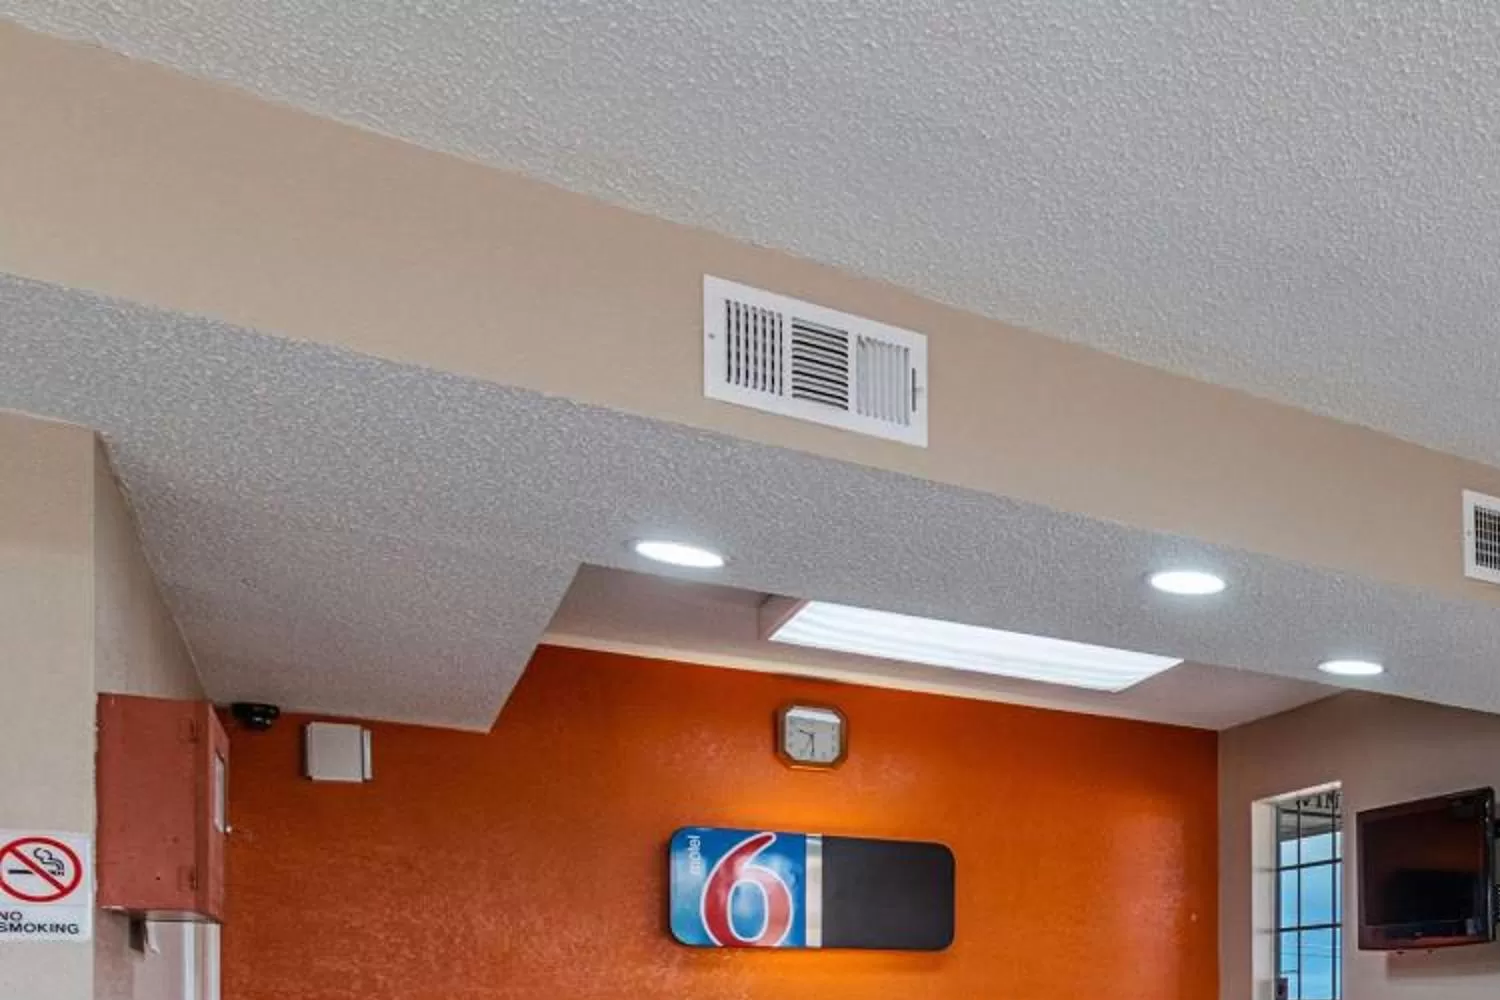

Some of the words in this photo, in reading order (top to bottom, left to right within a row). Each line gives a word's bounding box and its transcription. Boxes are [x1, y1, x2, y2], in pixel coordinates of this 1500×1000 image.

[687, 834, 701, 875] motel
[701, 831, 794, 947] 6
[0, 911, 23, 921] NO
[0, 922, 80, 935] SMOKING
